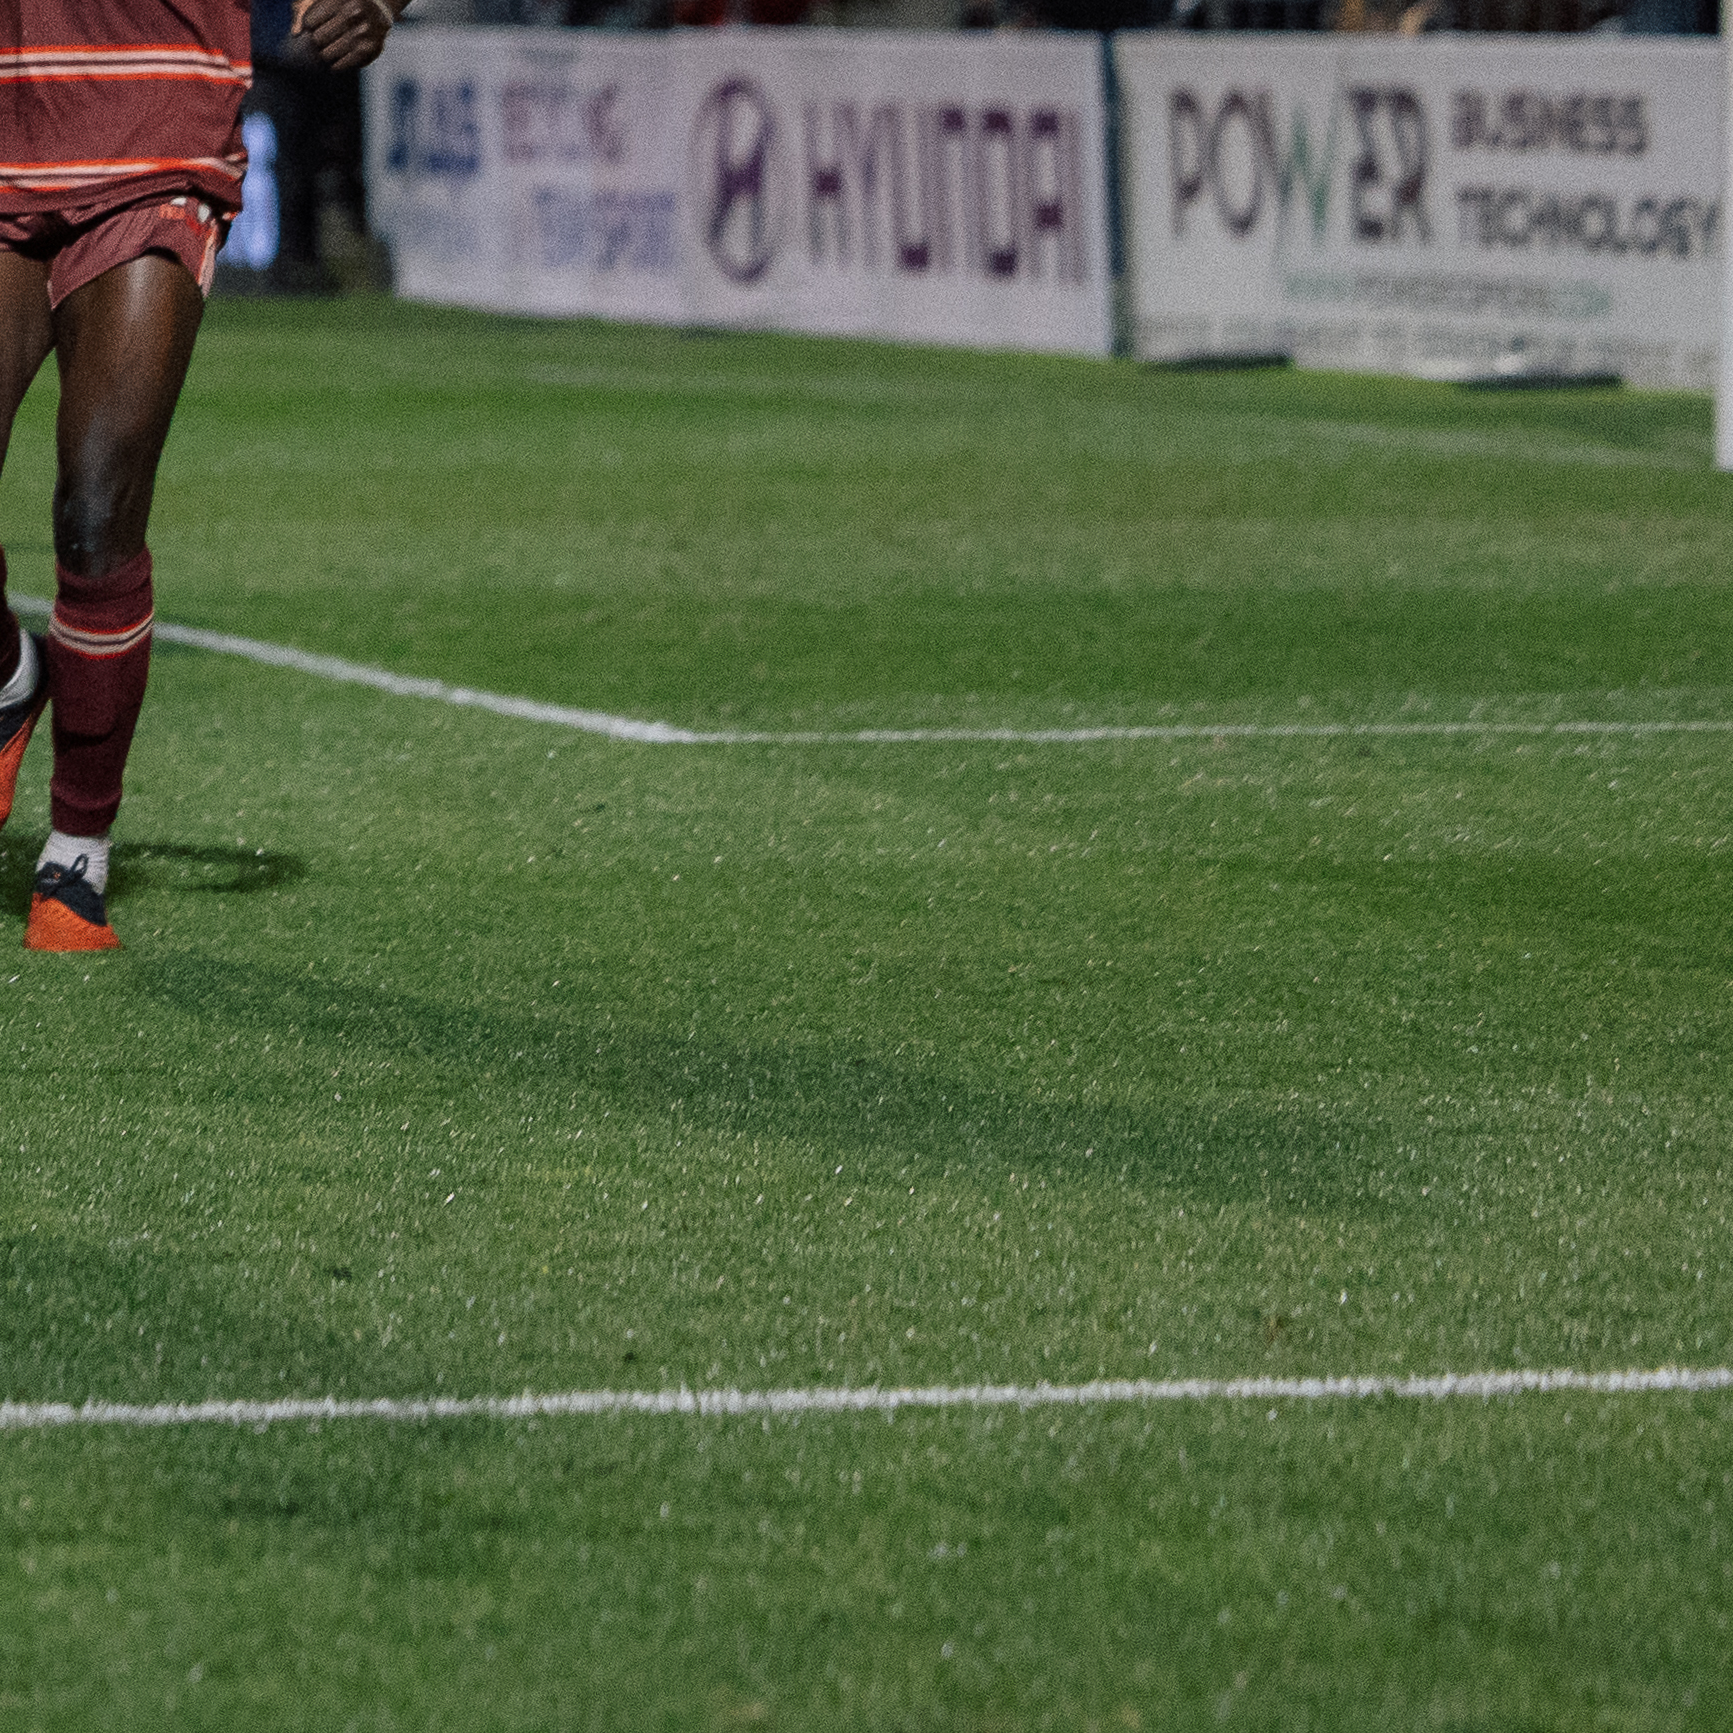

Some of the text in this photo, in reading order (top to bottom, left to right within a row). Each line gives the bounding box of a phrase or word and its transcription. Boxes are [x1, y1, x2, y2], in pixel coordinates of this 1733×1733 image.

[1167, 85, 1434, 246] POWER
[1452, 88, 1651, 157] BUSINESS
[803, 100, 1085, 282] HYUNDAI
[1459, 188, 1721, 260] TECHNOLOGY
